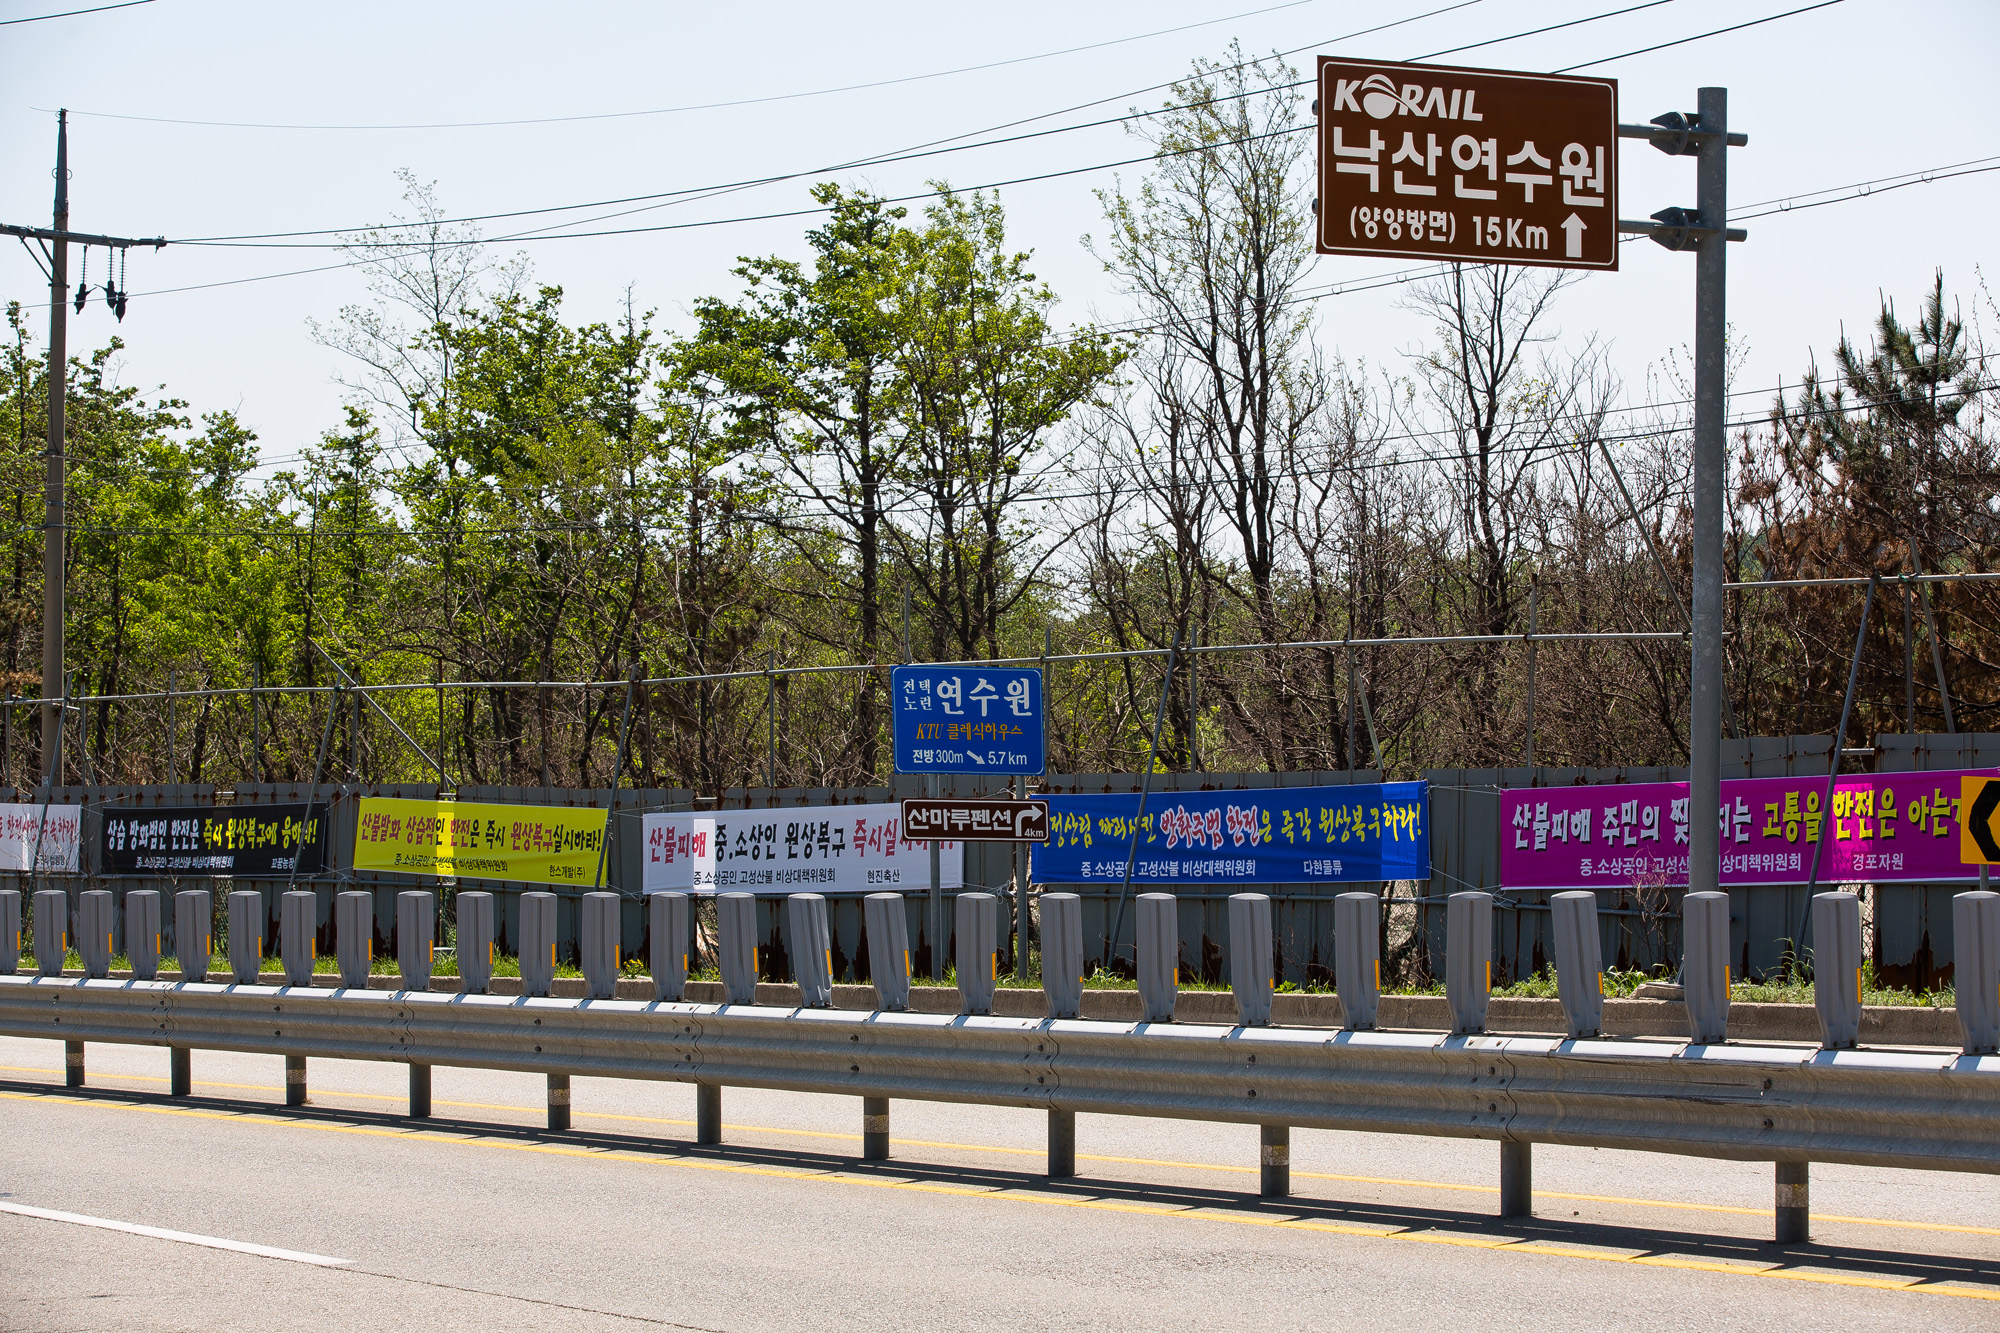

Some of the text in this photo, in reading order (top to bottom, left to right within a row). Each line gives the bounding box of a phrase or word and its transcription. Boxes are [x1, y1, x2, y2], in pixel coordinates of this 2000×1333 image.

[1333, 74, 1483, 122] KORAIL
[1333, 126, 1604, 207] 낙산연수원
[1350, 206, 1548, 250] (양양방면) 15Km
[936, 676, 1033, 717] 연수원
[915, 722, 1023, 741] KTU 클레식하우스
[107, 819, 126, 851] 상습
[129, 819, 167, 851] 방화범인
[171, 818, 199, 850] 한전은
[203, 818, 223, 851] 즉시
[225, 817, 278, 850] 원상복구에
[361, 813, 401, 842] 산불발화
[406, 815, 445, 846] 상습적인
[450, 818, 480, 848] 한전은
[485, 819, 506, 850] 즉시
[908, 808, 1044, 838] 산마루펜션 4km
[1044, 812, 1093, 849] 정산림
[1160, 804, 1224, 850] 방화주범
[1226, 804, 1273, 847] 한전은
[1281, 807, 1311, 844] 즉각
[1512, 801, 1592, 851] 산불피해
[1602, 799, 1660, 847] 주민의
[1762, 790, 1823, 843] 고통을
[1832, 787, 1898, 840] 한전은
[649, 826, 707, 864] 산불피해
[785, 818, 846, 860] 원상복구
[549, 864, 586, 879] 한스개발(주)
[740, 869, 773, 885] 고성산불
[776, 868, 836, 884] 비상대책위원회
[867, 868, 901, 884] 현진축산
[1138, 860, 1179, 877] 고성산불
[1182, 859, 1256, 877] 비상대책위원회
[1303, 859, 1343, 875] 다현물류
[1718, 853, 1801, 873] 상대책위원회
[1853, 853, 1904, 871] 경포자원
